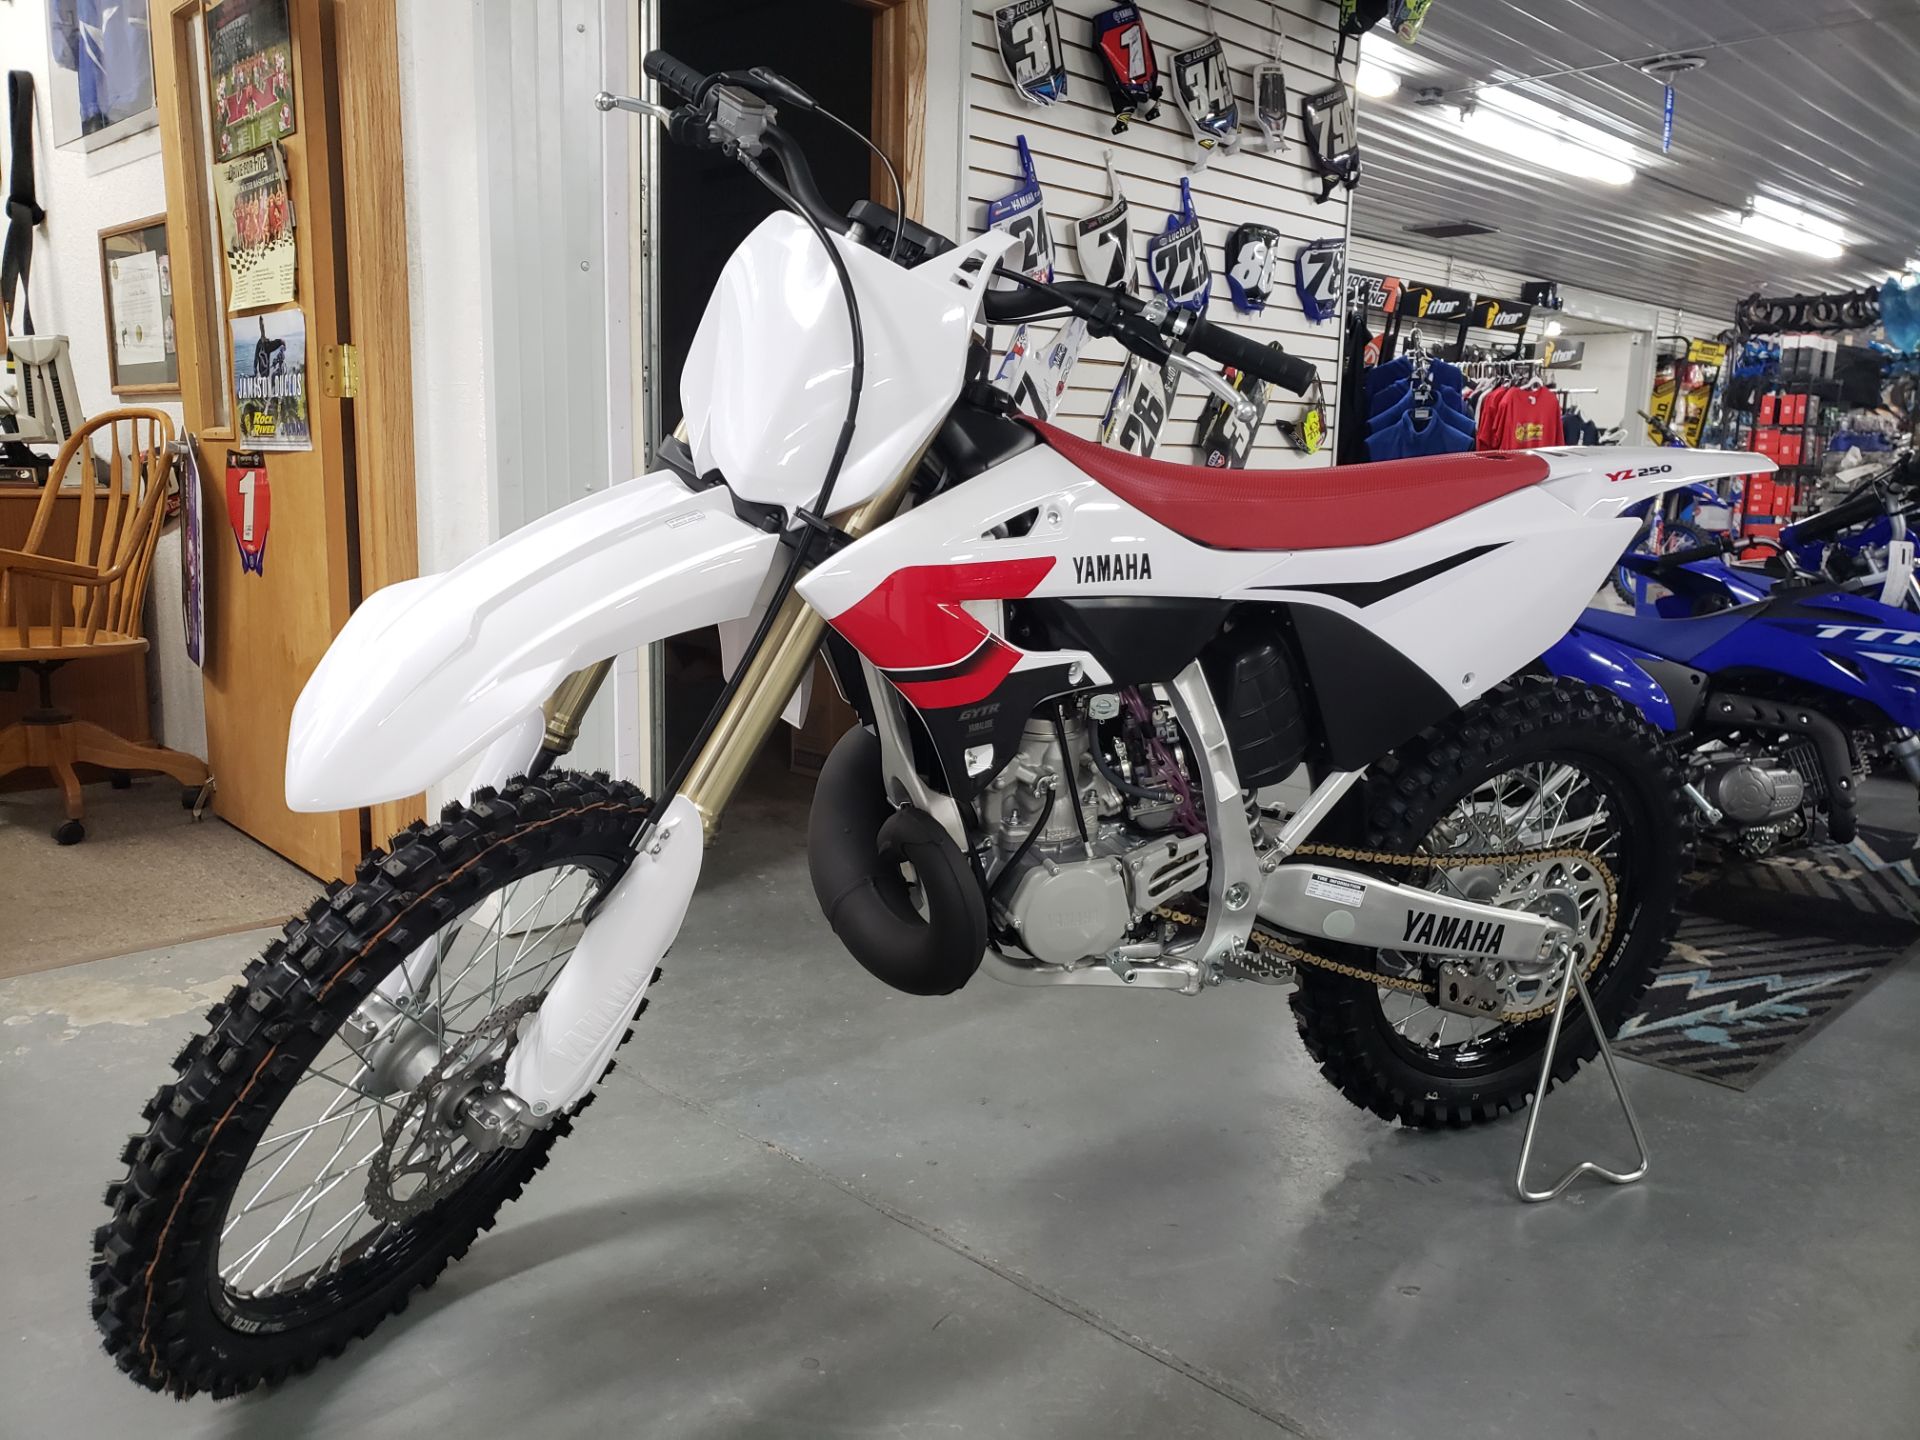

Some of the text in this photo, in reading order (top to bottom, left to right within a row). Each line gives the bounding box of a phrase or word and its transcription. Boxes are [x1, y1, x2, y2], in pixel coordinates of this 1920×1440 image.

[1011, 5, 1063, 86] 31
[1120, 25, 1146, 79] 1
[1011, 192, 1035, 211] YAMAHA
[1009, 206, 1049, 273] 24
[1168, 228, 1186, 243] LUCAS
[1097, 217, 1128, 287] 7
[1427, 298, 1459, 315] thor
[1493, 309, 1523, 326] thor
[1551, 347, 1577, 364] thor
[274, 373, 302, 398] DUCLOS
[253, 411, 273, 424] ROCK
[1119, 384, 1164, 458] 26
[253, 423, 276, 437] RIVER
[1605, 464, 1673, 482] YZ 250
[238, 470, 256, 542] 1
[1072, 553, 1153, 585] YAMAHA
[957, 702, 1002, 721] GYTR
[1402, 909, 1506, 955] YAMAHA
